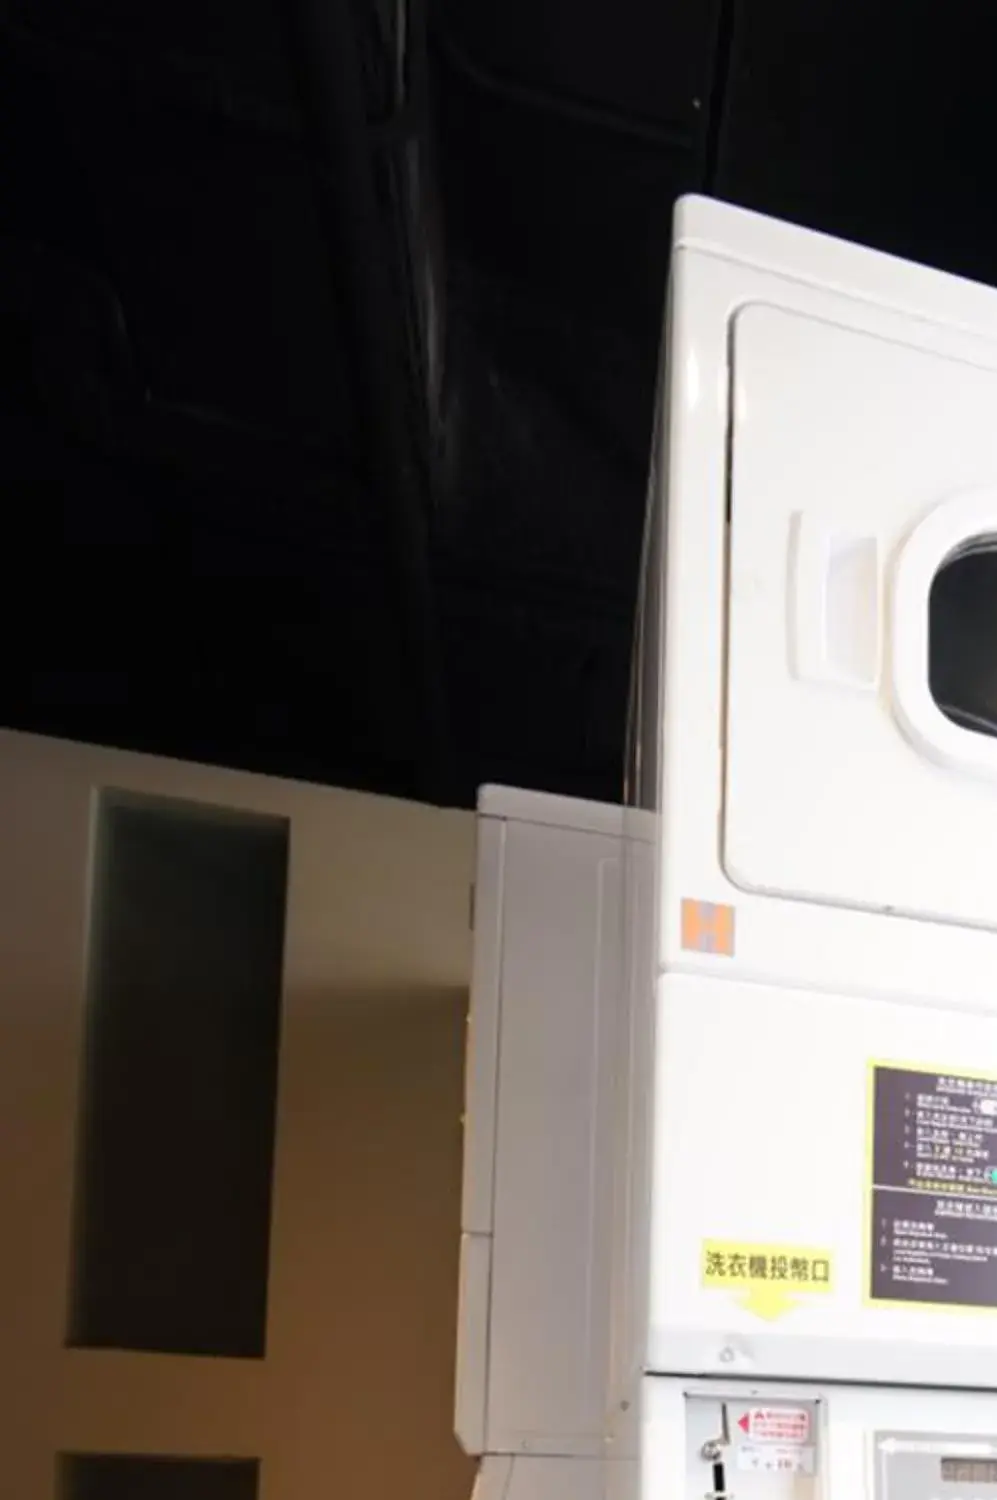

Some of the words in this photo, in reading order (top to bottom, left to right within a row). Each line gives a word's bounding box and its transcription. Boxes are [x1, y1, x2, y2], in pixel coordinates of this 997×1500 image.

[704, 1250, 830, 1283] 洗衣機投幣口
